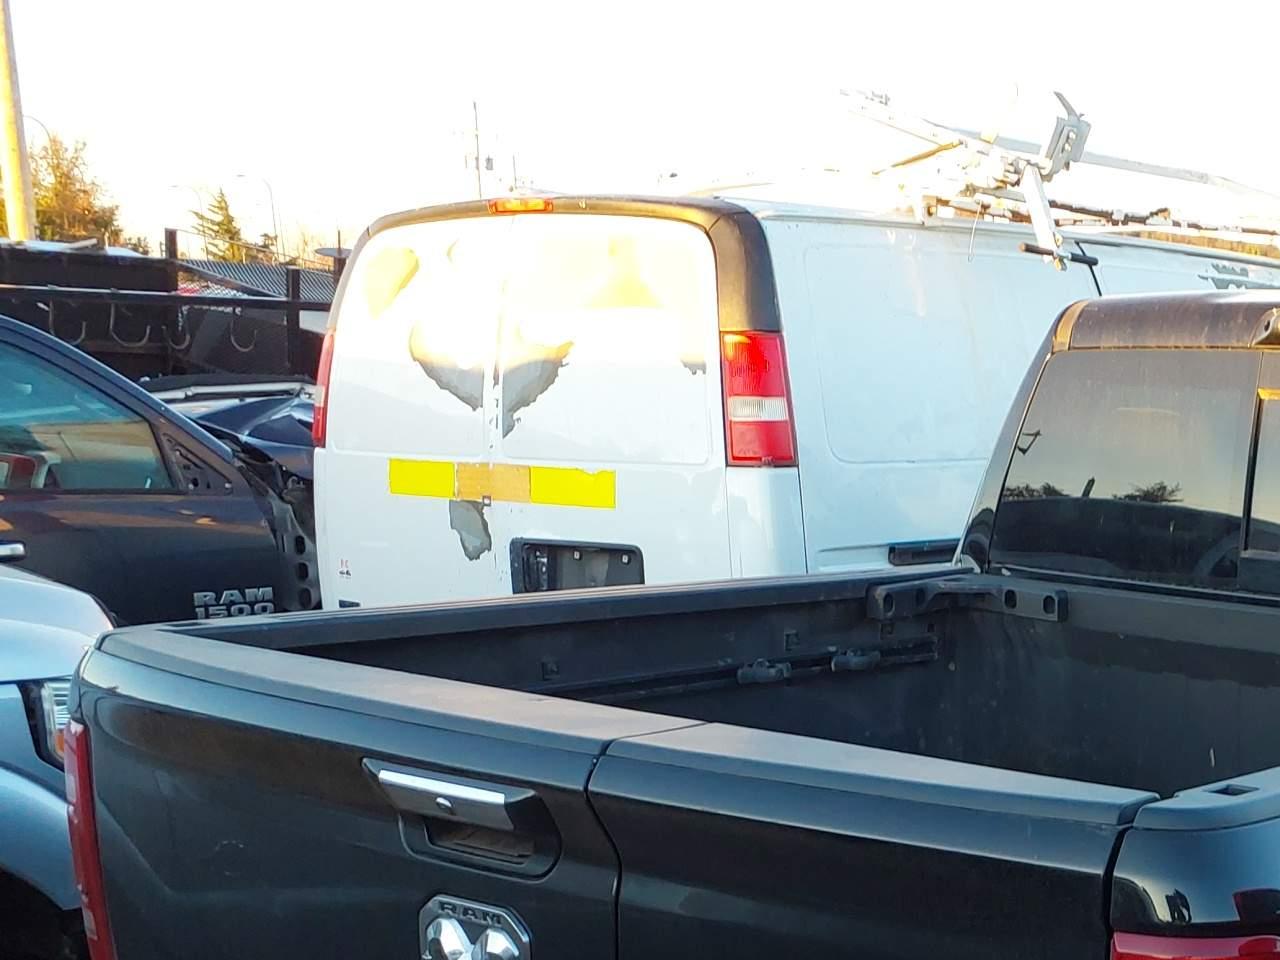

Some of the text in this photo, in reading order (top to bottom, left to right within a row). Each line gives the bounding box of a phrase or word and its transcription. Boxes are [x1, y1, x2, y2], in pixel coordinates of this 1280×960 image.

[193, 586, 275, 607] RAM
[195, 602, 275, 620] 1500
[439, 901, 503, 926] RAM
